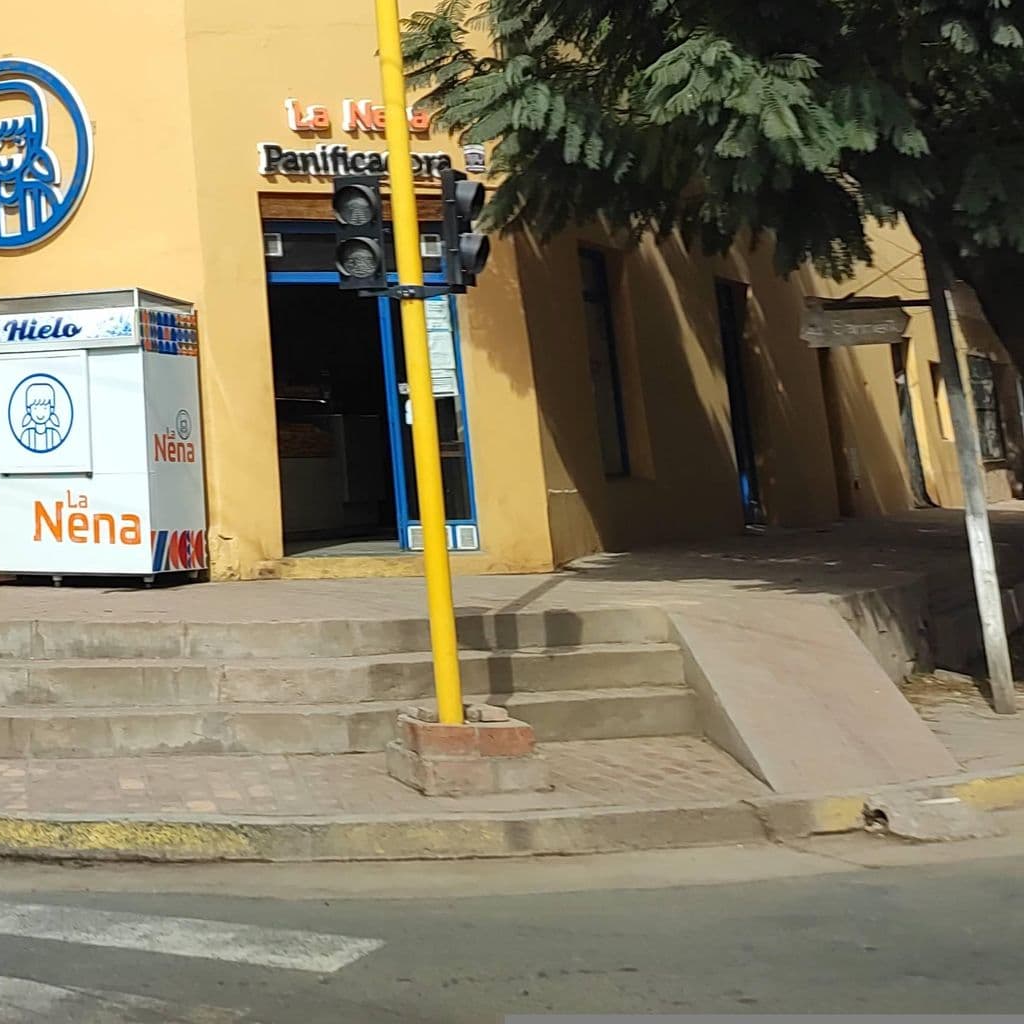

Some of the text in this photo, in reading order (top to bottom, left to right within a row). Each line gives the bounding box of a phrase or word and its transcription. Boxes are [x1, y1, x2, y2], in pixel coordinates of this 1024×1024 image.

[285, 98, 430, 132] La Nea
[258, 143, 452, 176] Panificaora
[3, 317, 82, 341] Hielo
[154, 433, 195, 463] Nena
[66, 489, 88, 508] La
[33, 500, 142, 545] Nena
